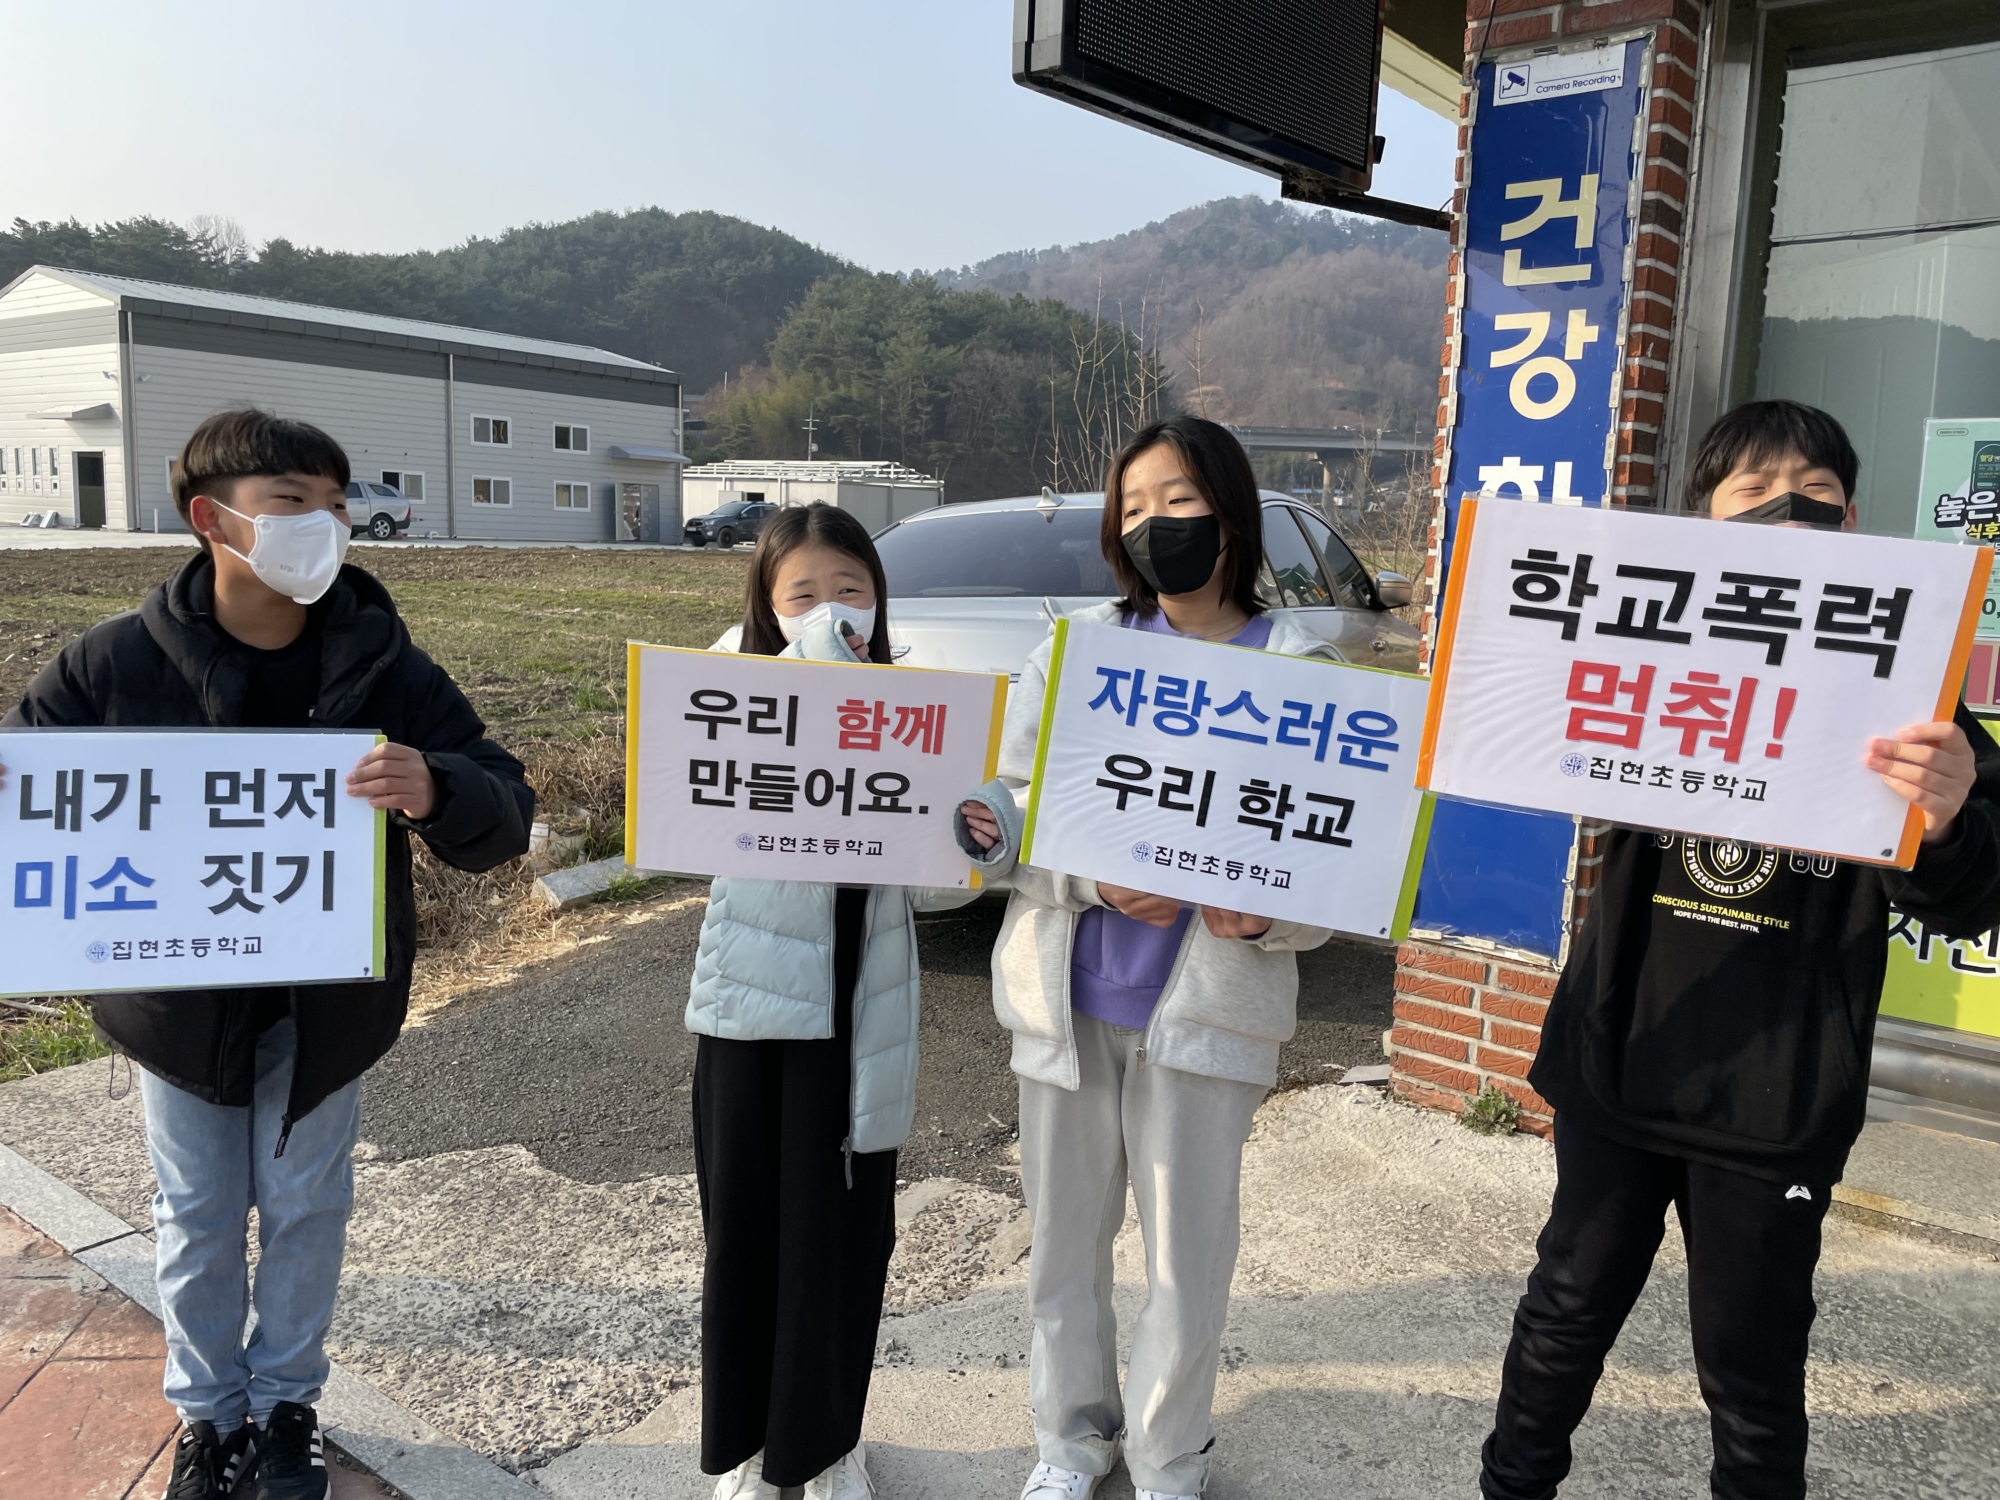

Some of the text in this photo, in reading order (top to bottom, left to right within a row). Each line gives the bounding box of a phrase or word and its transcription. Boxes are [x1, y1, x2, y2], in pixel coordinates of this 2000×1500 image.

[1535, 74, 1617, 94] Camera Recording
[1935, 490, 1998, 523] 높은
[1508, 548, 1914, 680] 학교폭력
[684, 690, 948, 756] 우리 함께
[1087, 667, 1399, 773] 자랑스러운
[1565, 659, 1798, 764] 멈춰!
[19, 768, 337, 832] 내가 먼저
[688, 758, 930, 817] 만들어요.
[1095, 753, 1356, 849] 우리 학교
[1588, 756, 1768, 802] 집현초등학교
[756, 835, 884, 857] 집현초등학교
[1154, 844, 1292, 890] 집현초등학교
[1760, 854, 1774, 875] THE
[13, 850, 335, 920] 미소 짓기
[1686, 851, 1733, 894] IMPOSSIBLE
[1737, 874, 1763, 893] BEST
[1652, 894, 1791, 931] CONSCIOUS SUSTAINABLE STYLE
[1673, 910, 1692, 919] HOPE
[1692, 913, 1706, 922] FOR
[1707, 916, 1721, 925] THE
[111, 936, 263, 961] 집현초등학교
